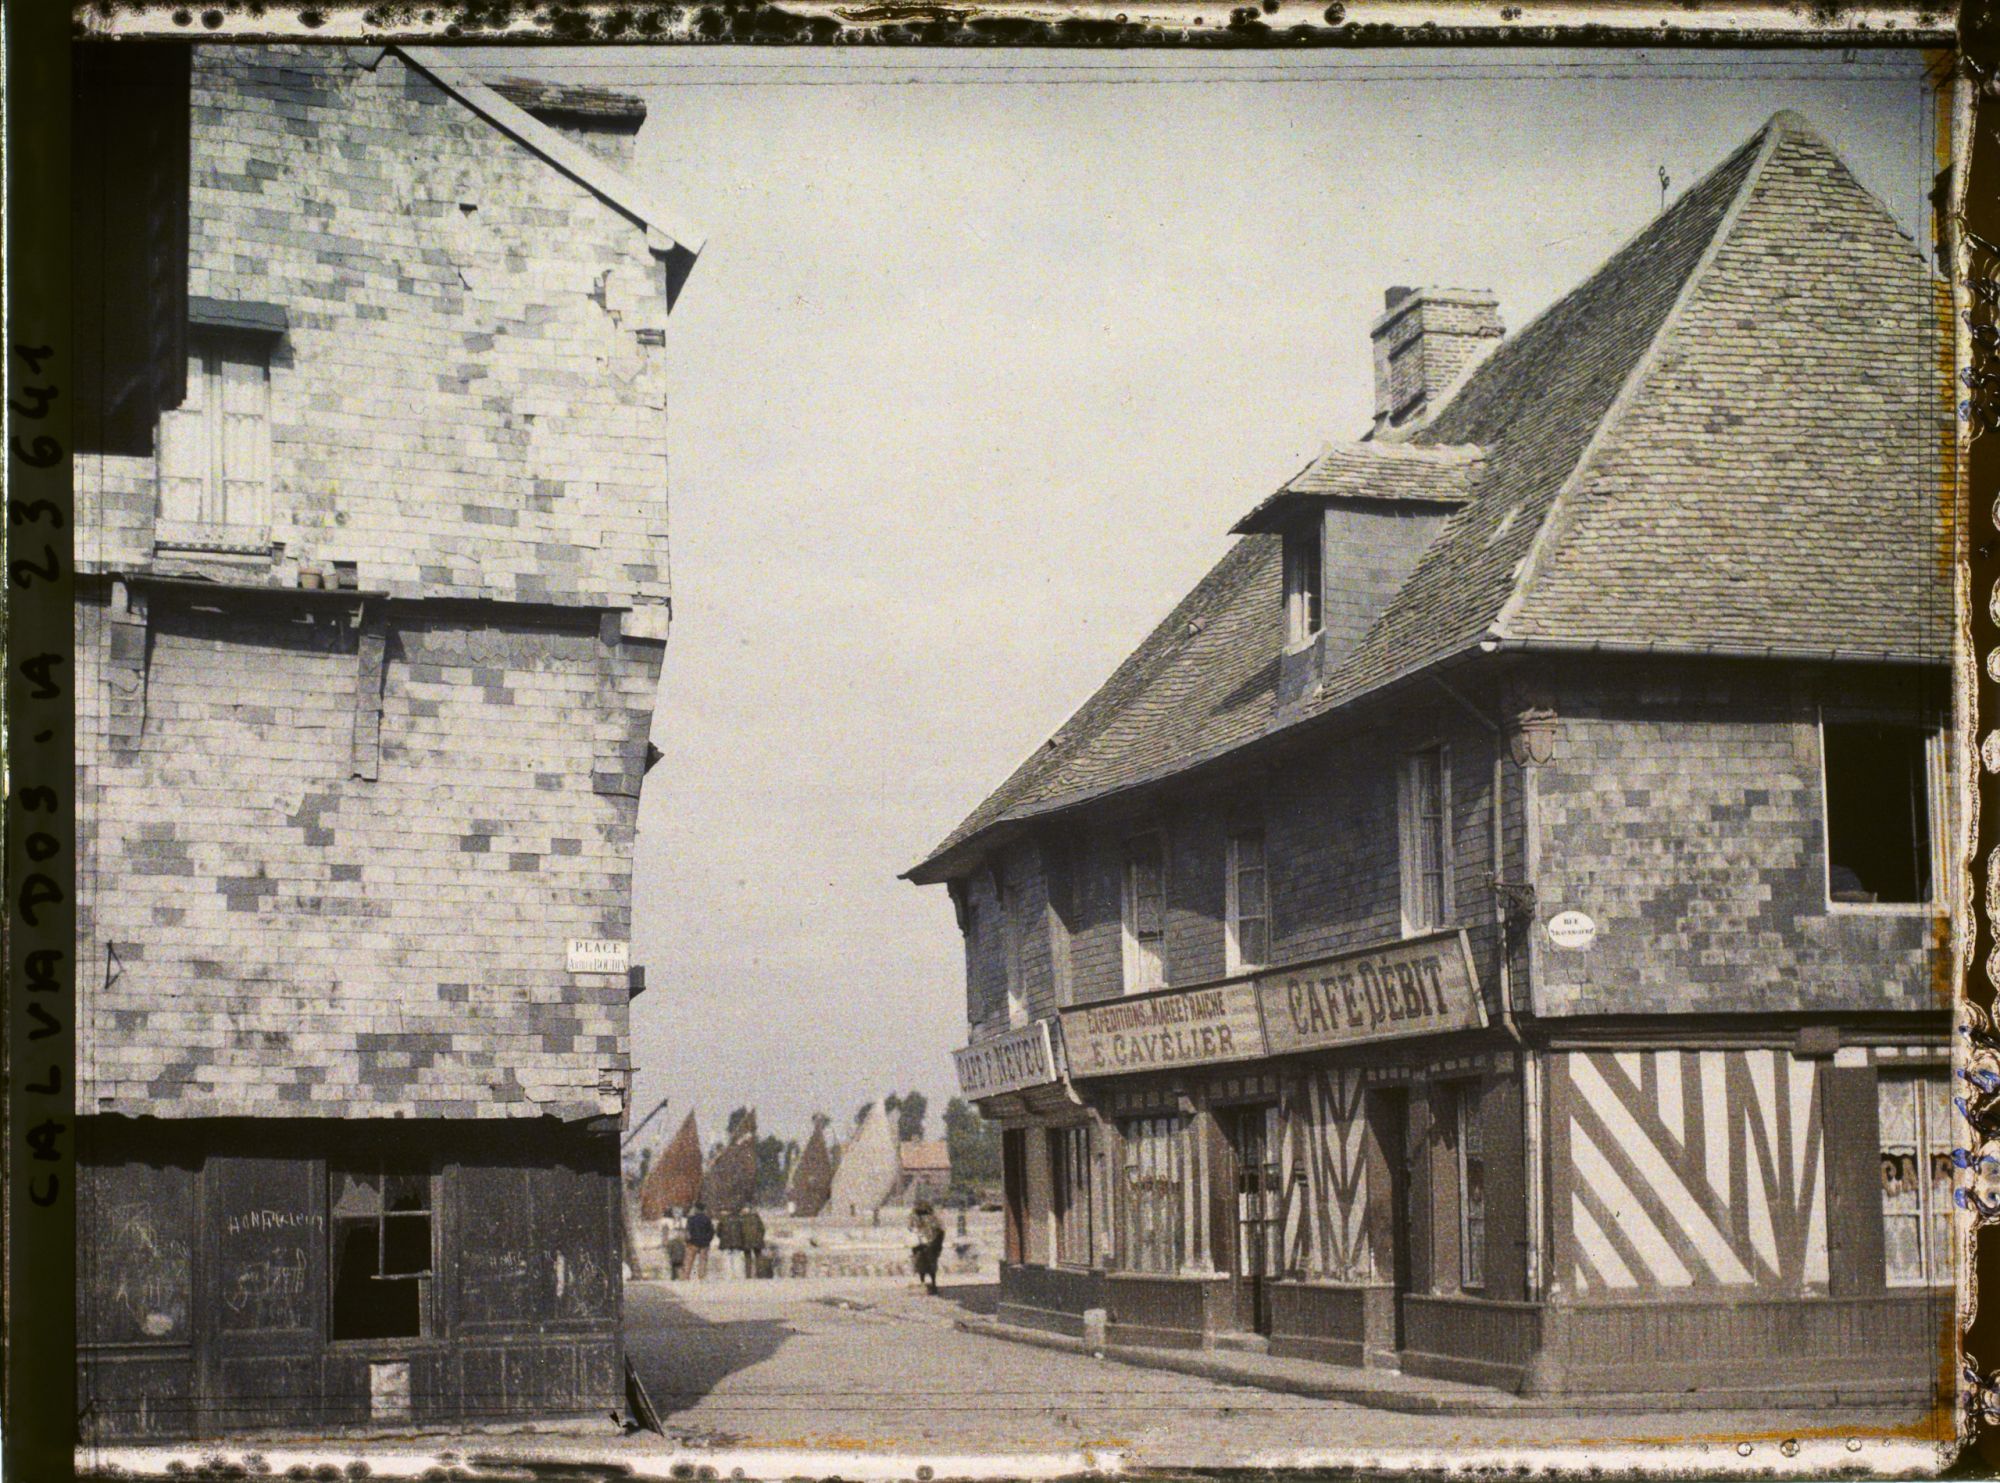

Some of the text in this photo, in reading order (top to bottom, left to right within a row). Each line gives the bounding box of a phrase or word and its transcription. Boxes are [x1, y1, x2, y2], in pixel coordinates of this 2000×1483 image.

[15, 343, 60, 590] 23641
[19, 650, 62, 699] A
[17, 785, 61, 1210] CALVADOS
[575, 941, 621, 954] PLACE
